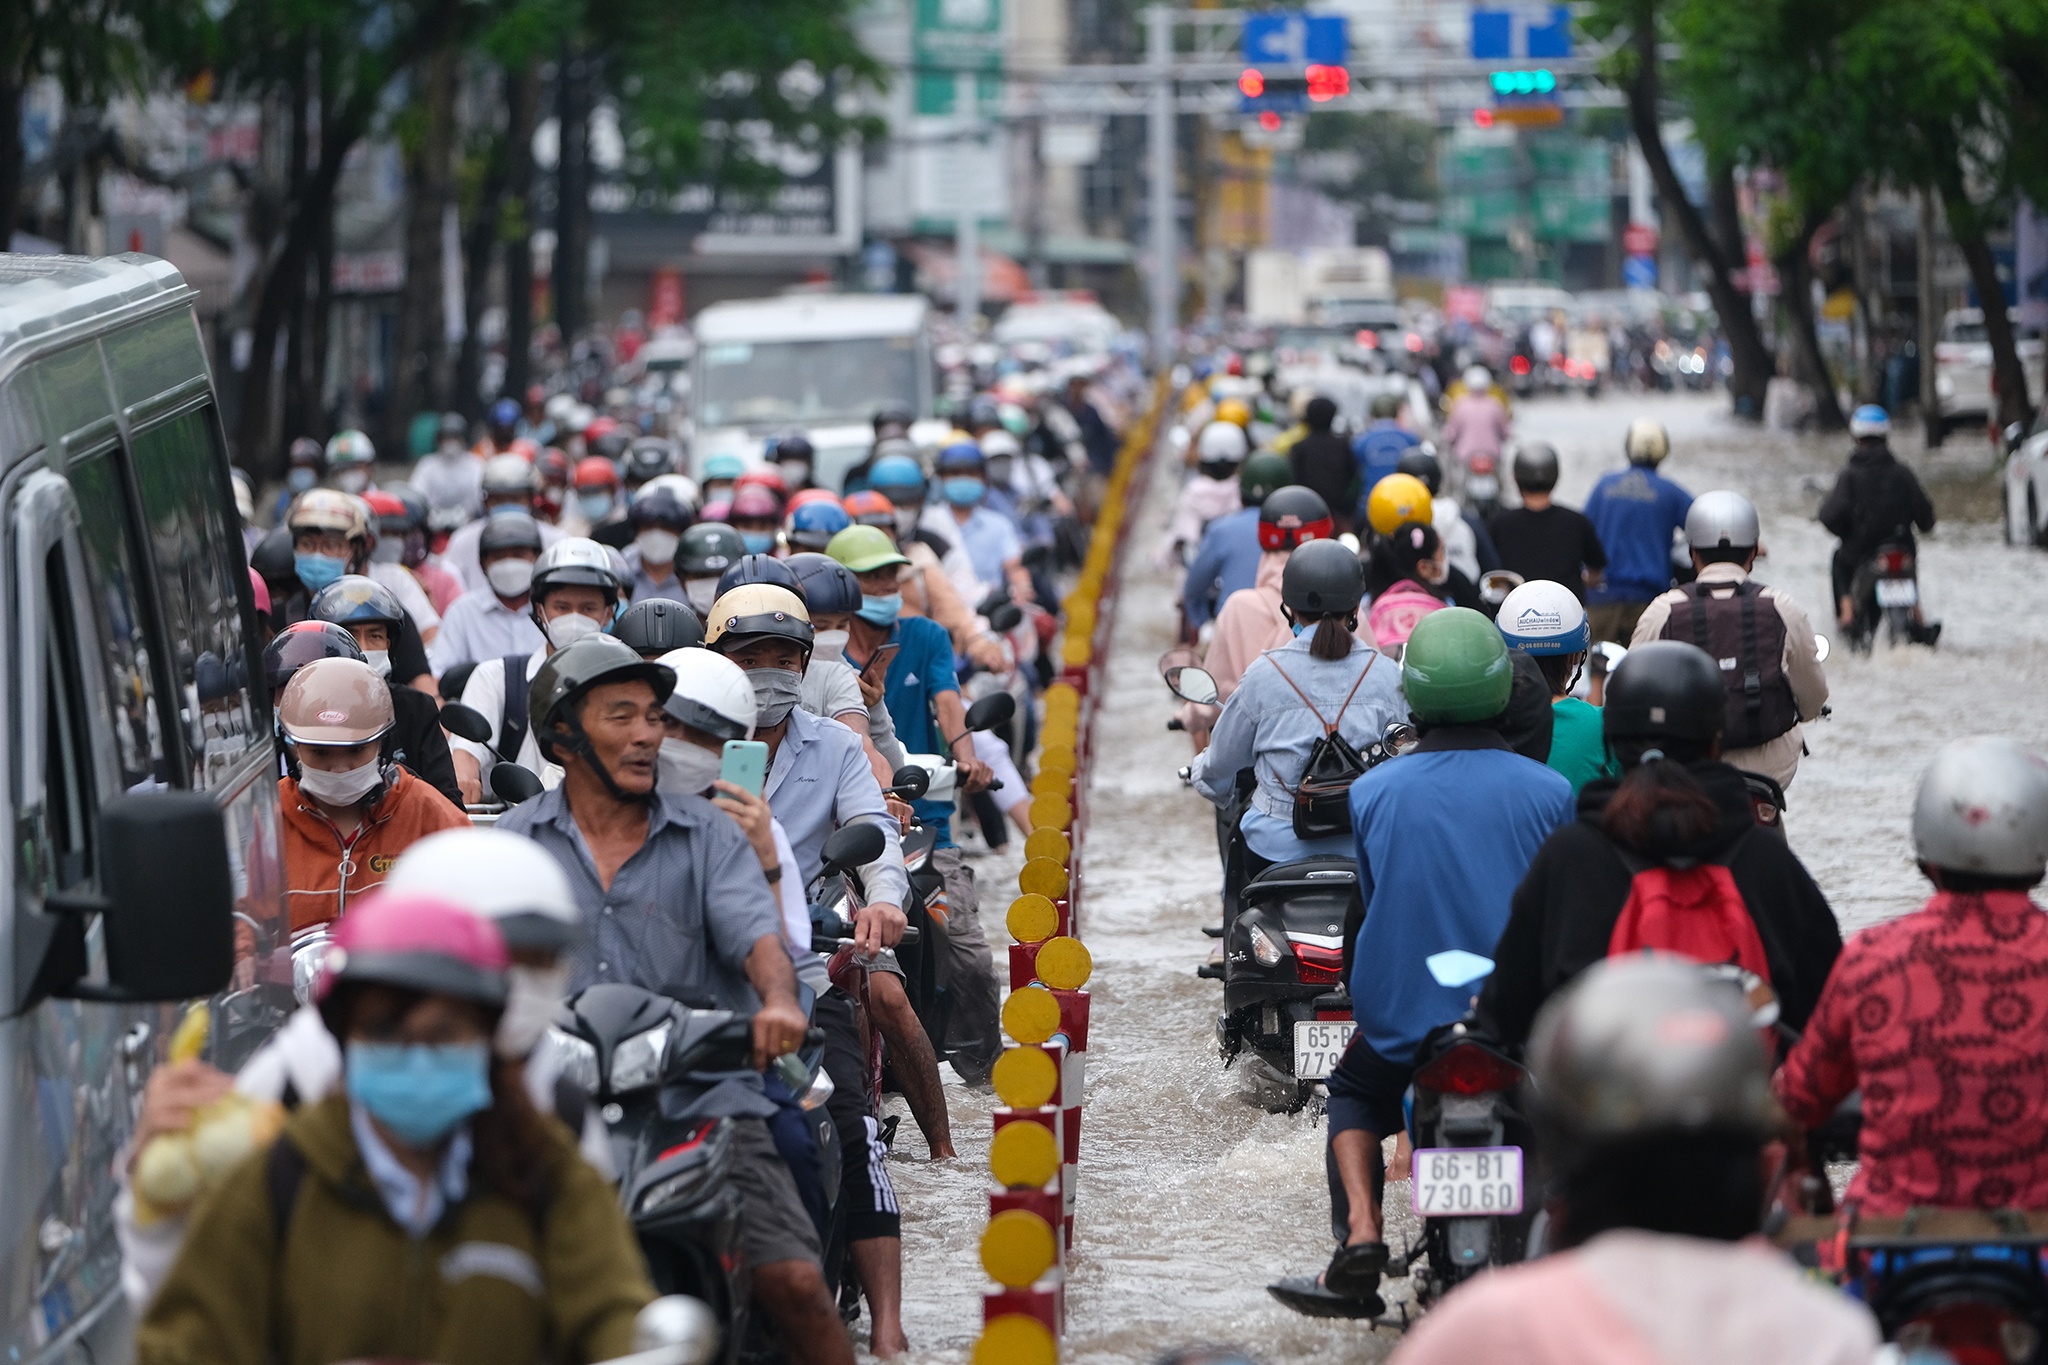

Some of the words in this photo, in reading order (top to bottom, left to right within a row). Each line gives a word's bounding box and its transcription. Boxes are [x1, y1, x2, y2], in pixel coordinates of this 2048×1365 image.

[1308, 1026, 1351, 1048] 65-B
[1300, 1052, 1339, 1075] 779
[1432, 1153, 1503, 1180] 66-B1
[1424, 1184, 1512, 1209] 730.60
